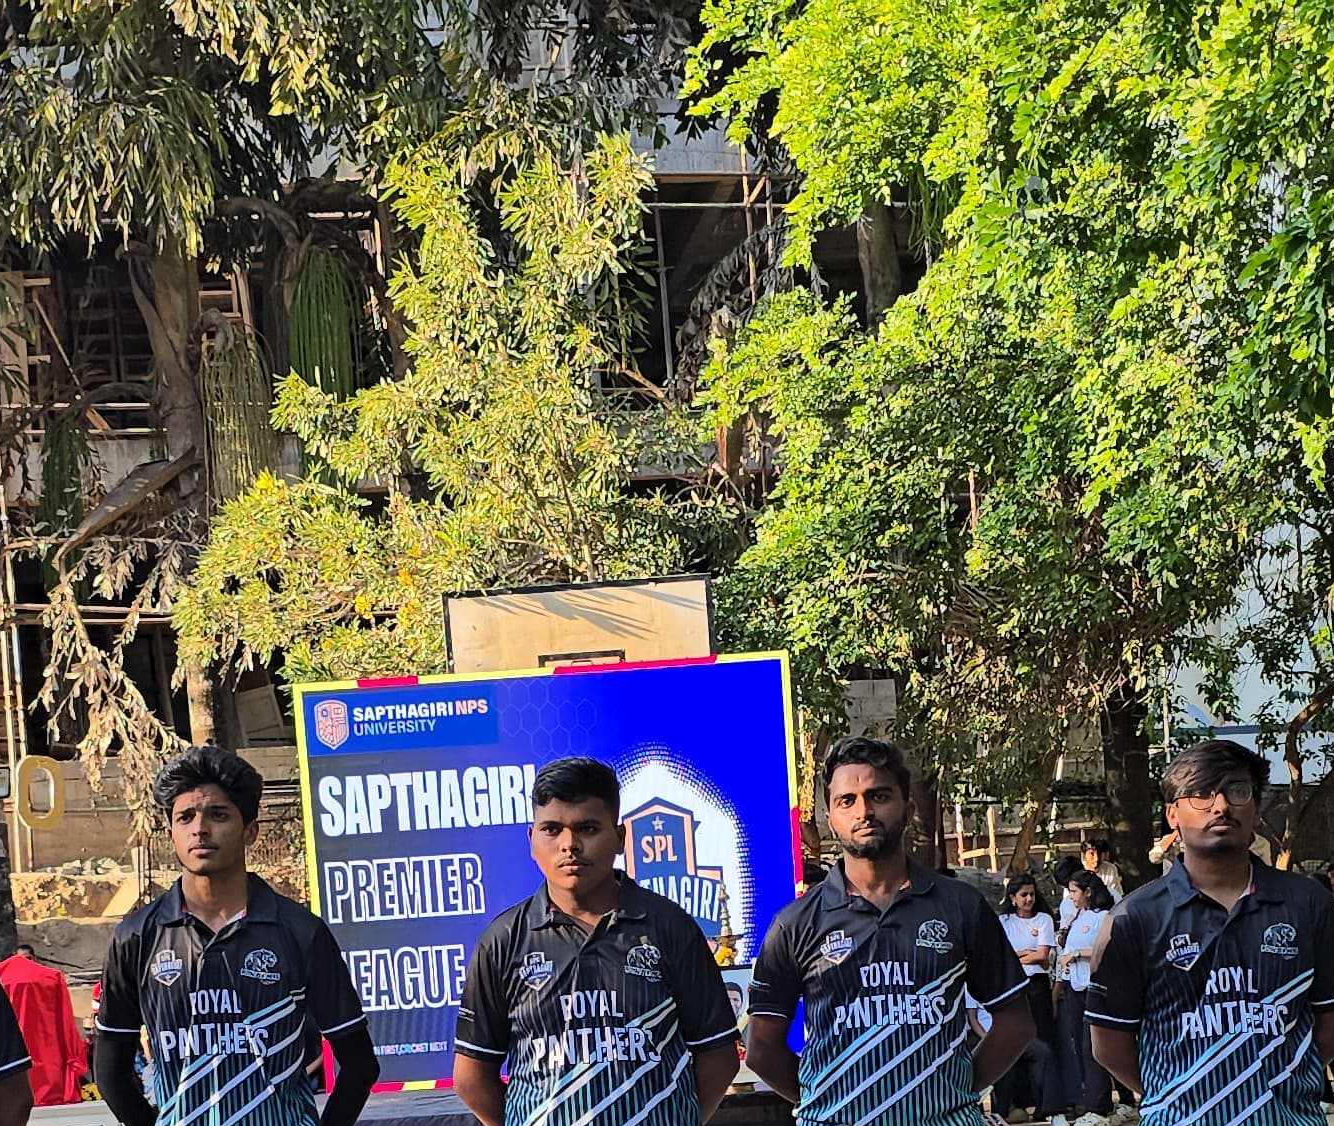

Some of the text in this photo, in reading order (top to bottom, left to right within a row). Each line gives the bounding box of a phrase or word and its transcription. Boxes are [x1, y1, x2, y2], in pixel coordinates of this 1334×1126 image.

[353, 699, 489, 722] SAPTHAGIRI NPS
[353, 718, 437, 737] UNIVERSITY
[318, 764, 536, 837] SAPTHAGIRI
[641, 835, 677, 863] SPL
[324, 853, 486, 924] PREMIER
[560, 989, 624, 1021] ROYAL
